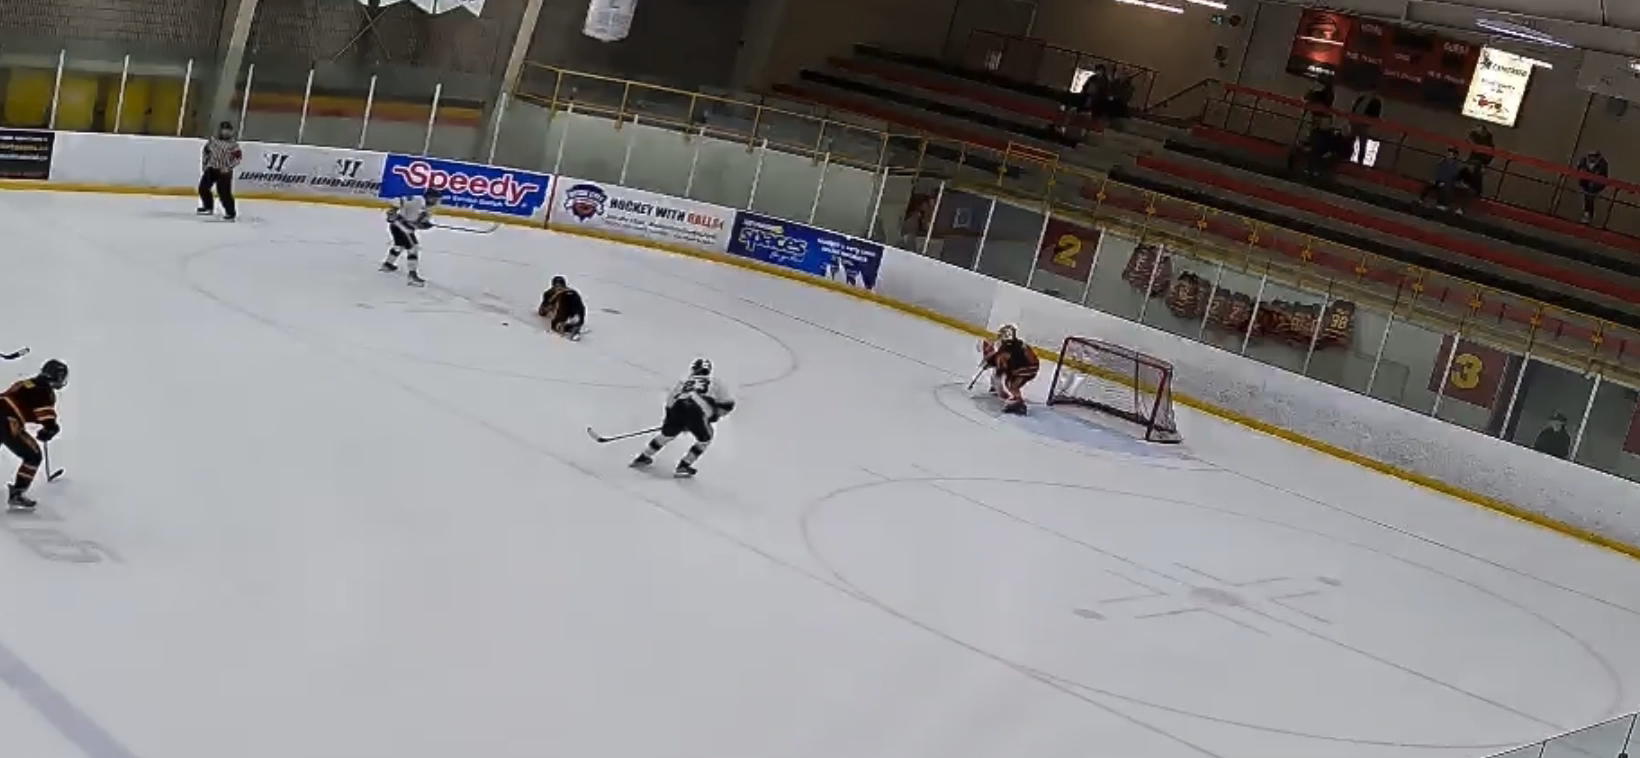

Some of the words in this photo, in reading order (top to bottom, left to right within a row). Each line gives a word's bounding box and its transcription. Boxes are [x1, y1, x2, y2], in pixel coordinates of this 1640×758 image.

[393, 161, 540, 206] Speedy
[608, 198, 652, 216] HOCKEY
[655, 206, 685, 222] WITH
[1053, 235, 1082, 268] 2
[1451, 353, 1483, 389] 3
